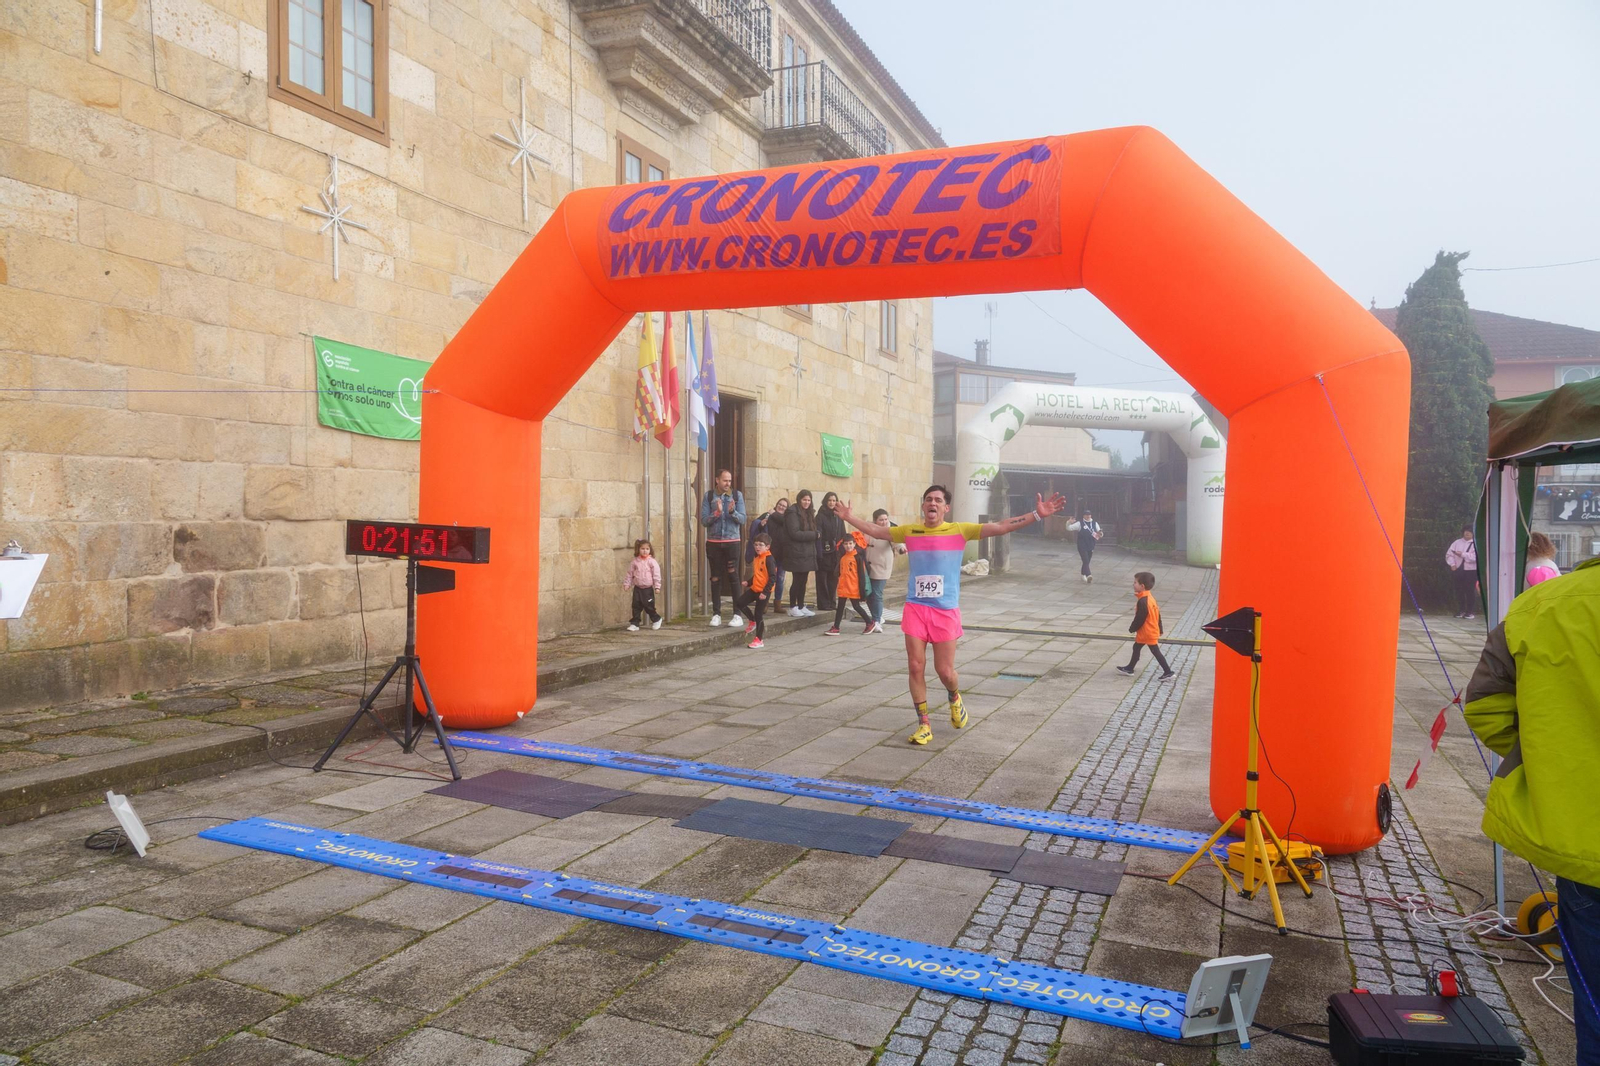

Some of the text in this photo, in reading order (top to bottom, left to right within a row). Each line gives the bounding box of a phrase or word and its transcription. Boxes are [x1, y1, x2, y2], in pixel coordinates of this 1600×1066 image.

[608, 144, 1052, 233] CRONOTEC
[610, 219, 1037, 278] WWW.CRONOTEC.ES
[326, 374, 395, 399] ontra el cáncer
[355, 395, 375, 406] solo
[376, 399, 391, 409] uno
[1036, 393, 1084, 409] HOTEL
[1092, 396, 1109, 410] LA
[1034, 410, 1120, 421] www.hotelrectoral.com
[362, 525, 448, 557] 0:21:51
[919, 582, 938, 592] 549
[998, 813, 1108, 832] CRONOTEC
[1121, 828, 1225, 849] RONOTEC
[315, 843, 419, 867] CRONOTEC
[470, 861, 530, 875] CRONOTEC
[590, 884, 655, 899] CRONOTEC
[724, 908, 797, 925] CRONOTEC
[827, 943, 982, 980] CRONOTEC
[997, 977, 1171, 1018] CRONOTEC
